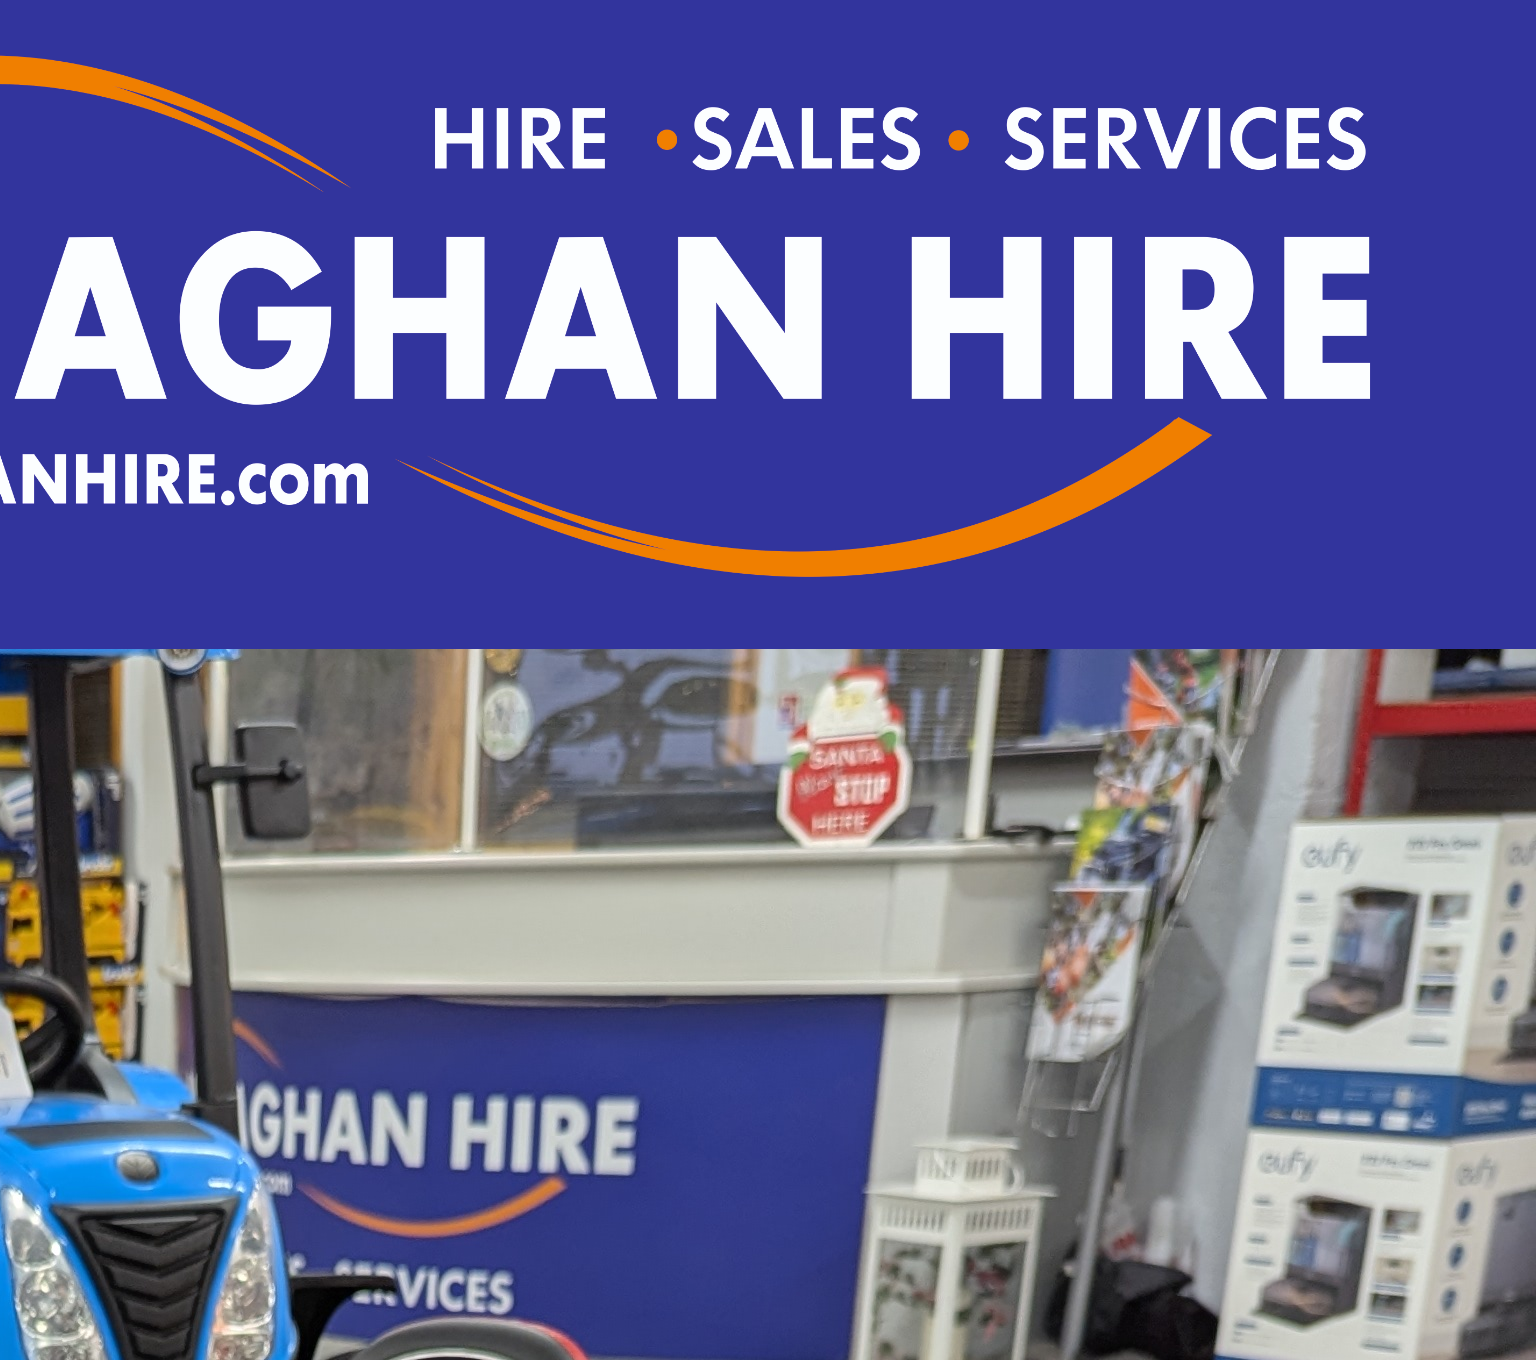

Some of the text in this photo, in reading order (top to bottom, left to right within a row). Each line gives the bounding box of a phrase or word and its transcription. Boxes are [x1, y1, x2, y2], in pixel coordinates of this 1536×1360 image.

[809, 744, 885, 769] SANTA
[833, 772, 891, 806] STOP
[1301, 836, 1361, 874] eufy
[450, 1091, 640, 1176] HIRE
